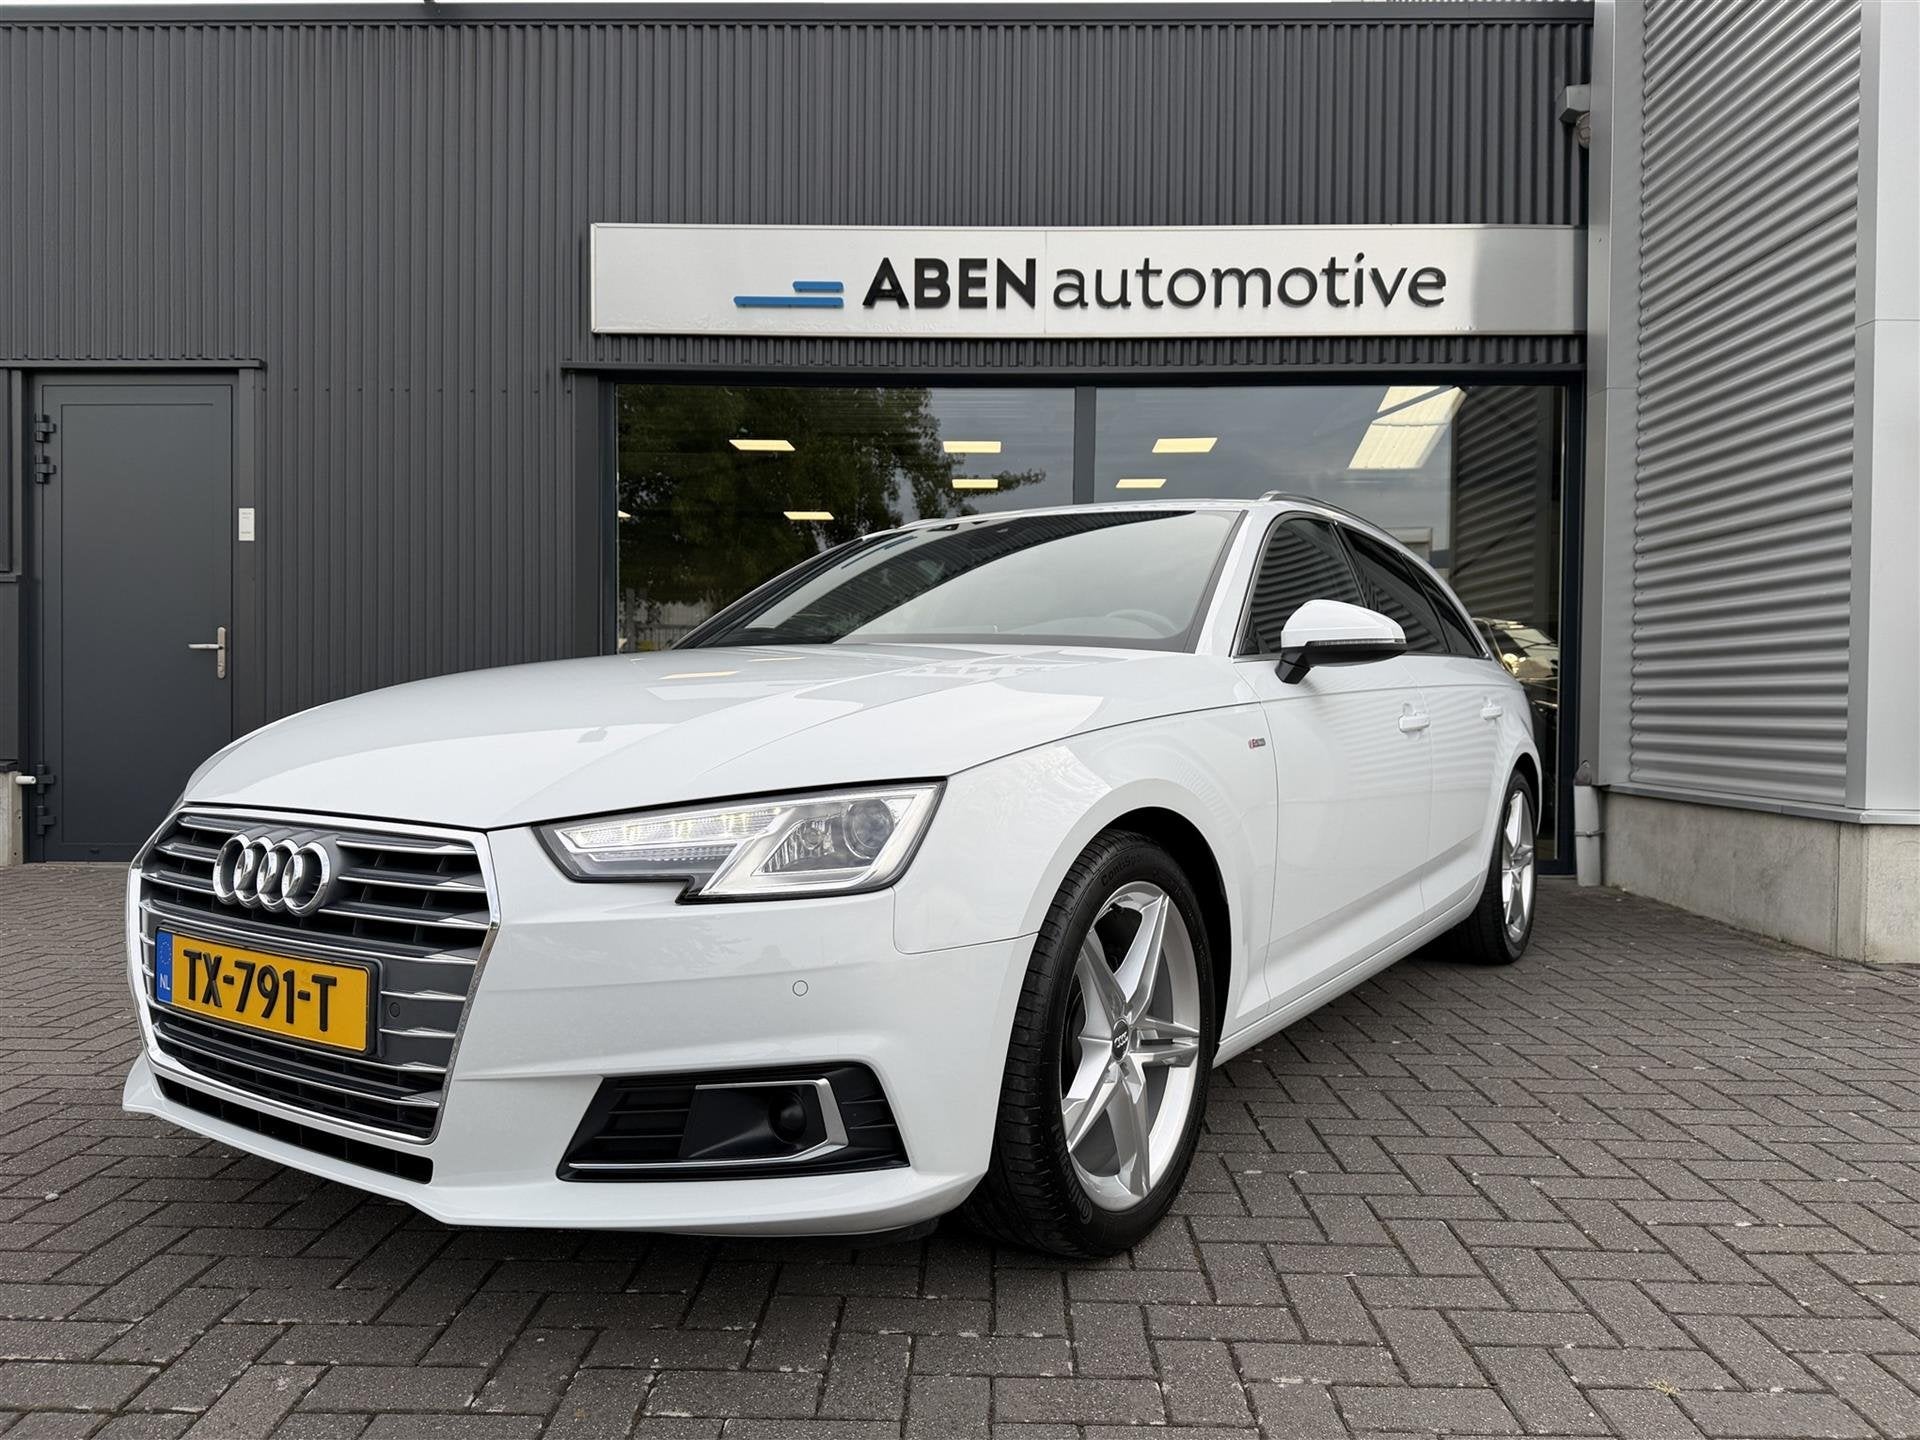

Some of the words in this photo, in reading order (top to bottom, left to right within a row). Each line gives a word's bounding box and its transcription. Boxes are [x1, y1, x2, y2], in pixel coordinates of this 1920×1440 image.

[862, 257, 1037, 309] ABEN
[1053, 252, 1447, 309] automotive
[159, 974, 171, 991] NL
[183, 949, 338, 1032] TX-791-T
